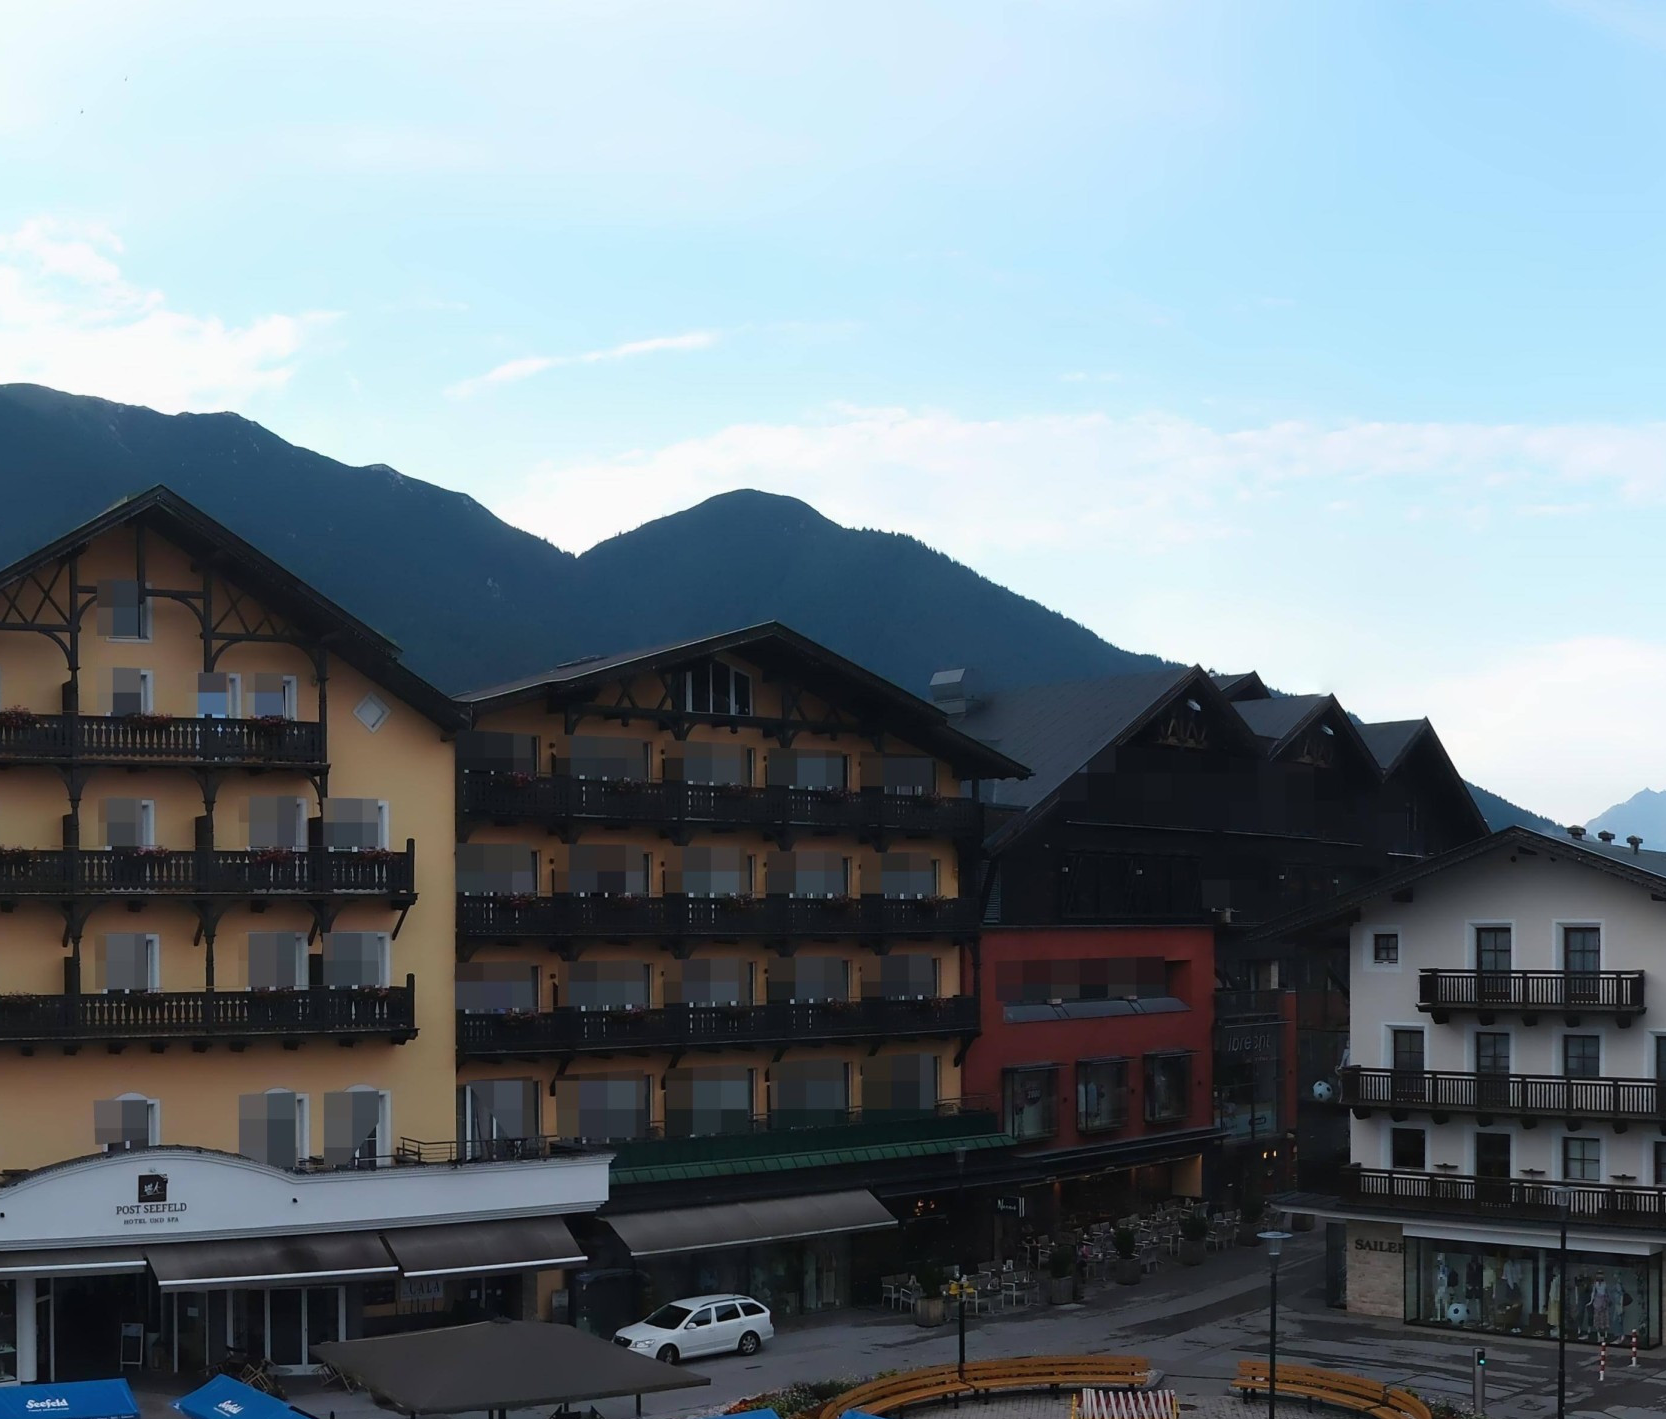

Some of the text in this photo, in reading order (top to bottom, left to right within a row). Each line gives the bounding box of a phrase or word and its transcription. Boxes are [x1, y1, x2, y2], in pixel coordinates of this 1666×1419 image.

[116, 1202, 187, 1215] POST SEEFELD
[25, 1398, 69, 1410] Seefeld
